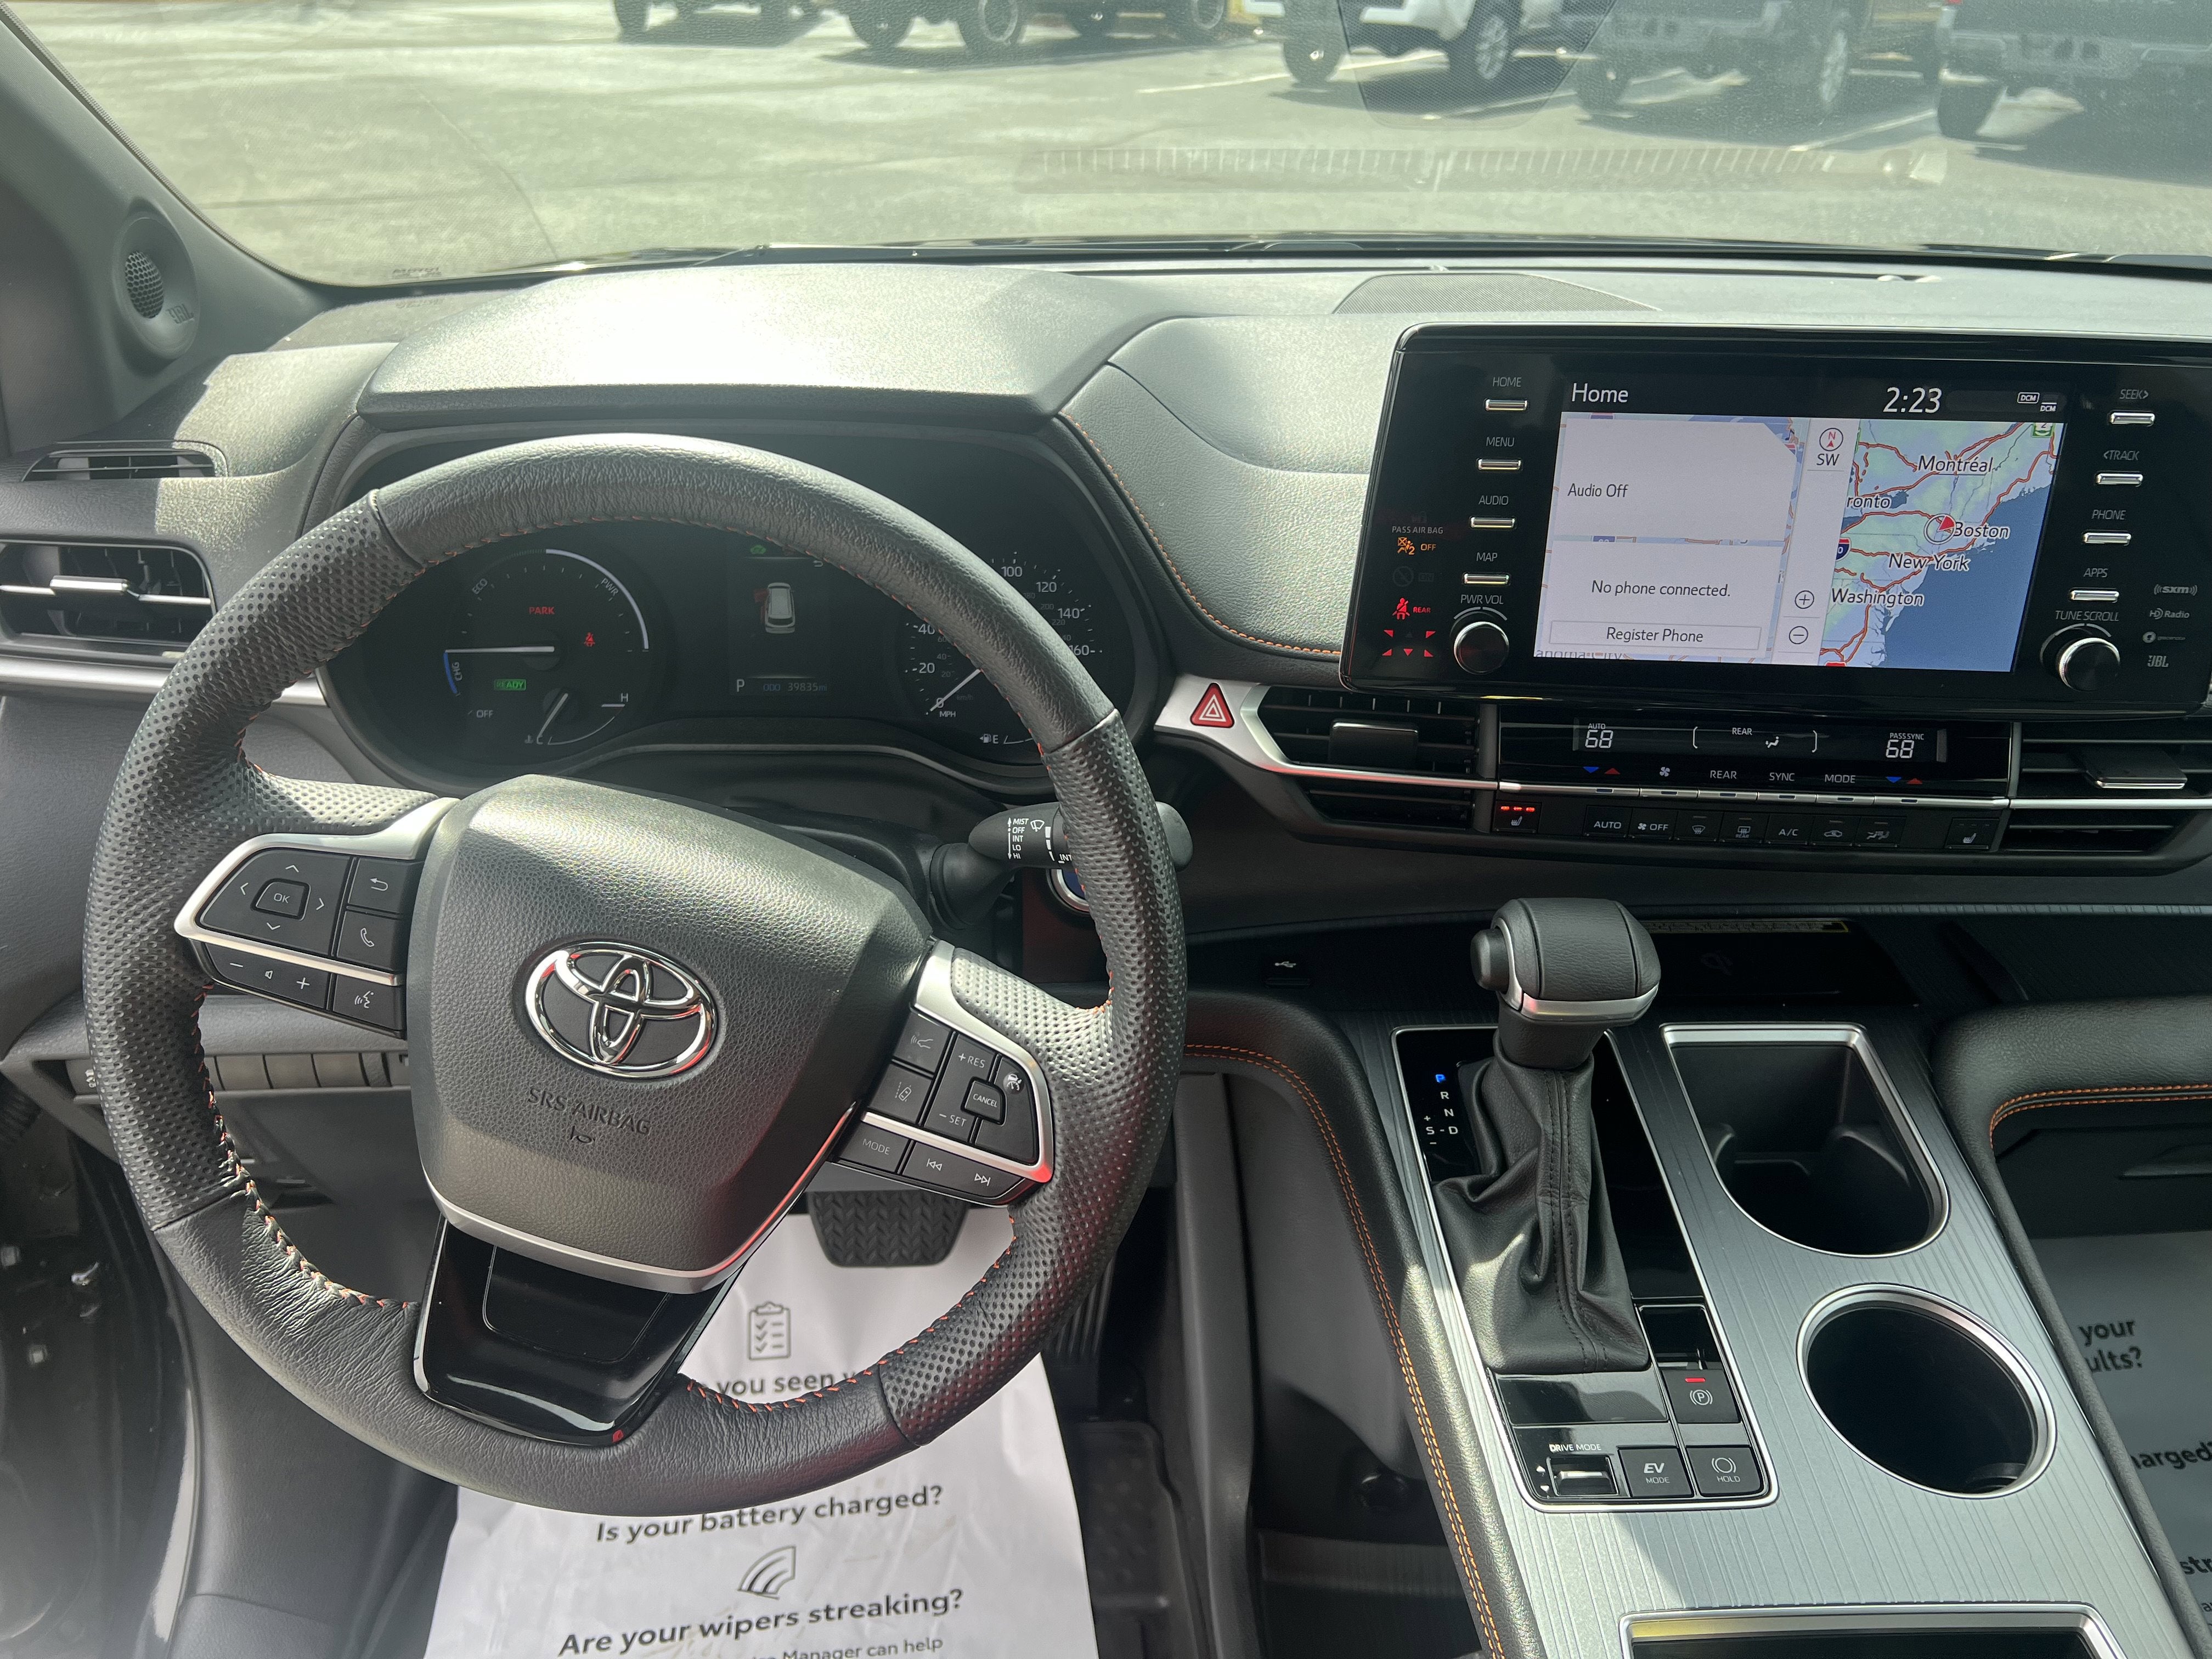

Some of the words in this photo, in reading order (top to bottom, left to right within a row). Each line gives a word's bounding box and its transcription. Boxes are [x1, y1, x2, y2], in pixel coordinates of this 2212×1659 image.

[1492, 377, 1521, 387] HOME
[1571, 383, 1629, 403] Home
[1883, 387, 1943, 413] 2:23
[1486, 437, 1515, 447] MENU
[1816, 454, 1839, 466] SW
[1918, 455, 1993, 474] Montréal
[1567, 483, 1602, 498] Audio
[1606, 484, 1629, 498] Off
[1479, 495, 1509, 505] AUDIO
[2092, 510, 2126, 521] PHONE
[1427, 527, 1443, 535] BAG
[1955, 522, 2010, 540] Boston
[1476, 552, 1498, 562] MAP
[1888, 554, 1927, 570] New
[1933, 554, 1970, 572] York
[1001, 567, 1023, 578] 100
[2084, 567, 2108, 579] APPS
[472, 578, 488, 595] ECO
[601, 578, 619, 596] PWR
[1036, 582, 1058, 593] 120
[1592, 580, 1612, 594] No
[1615, 581, 1656, 597] phone
[1659, 584, 1731, 597] connected.
[1460, 595, 1483, 604] PWR
[1485, 595, 1504, 605] VOL
[1831, 587, 1924, 608] Washington
[529, 606, 555, 615] PARK
[1058, 608, 1080, 619] 140
[2164, 610, 2191, 618] Radio
[2055, 611, 2082, 622] TUNE
[2083, 611, 2120, 622] SCROLL
[918, 623, 935, 635] 40
[1606, 627, 1660, 643] Register
[1662, 628, 1703, 642] Phone
[2147, 655, 2169, 668] JBL
[452, 661, 463, 681] CHG
[919, 662, 935, 674] 20
[495, 680, 525, 690] READY
[736, 679, 745, 692] P
[620, 693, 629, 702] H
[476, 709, 493, 718] OFF
[939, 710, 956, 718] MPH
[1732, 727, 1752, 736] REAR
[993, 735, 998, 743] E
[1584, 730, 1613, 749] 68
[1886, 740, 1915, 759] 68
[1710, 770, 1737, 779] REAR
[1769, 772, 1795, 782] SYNC
[1825, 775, 1856, 784] MODE
[1594, 821, 1622, 830] AUTO
[1779, 828, 1799, 837] A/C
[274, 893, 290, 904] OK
[1435, 1074, 1446, 1083] P
[972, 1093, 997, 1108] CANCEL
[527, 1087, 567, 1111] SRS
[572, 1104, 653, 1135] AIRBAG
[1426, 1126, 1435, 1135] S
[1448, 1126, 1458, 1135] D
[863, 1138, 890, 1155] MODE
[2079, 1321, 2135, 1347] your
[717, 1375, 764, 1396] you
[772, 1373, 834, 1394] seen
[1644, 1463, 1664, 1474] EV
[596, 1522, 618, 1543] Is
[626, 1516, 693, 1545] your
[701, 1505, 806, 1533] battery
[814, 1485, 943, 1520] charged?
[557, 1633, 612, 1657] Are
[620, 1623, 692, 1655] your
[698, 1612, 799, 1641] wipers
[808, 1589, 963, 1624] streaking?
[866, 1643, 899, 1657] can
[902, 1637, 944, 1655] help
